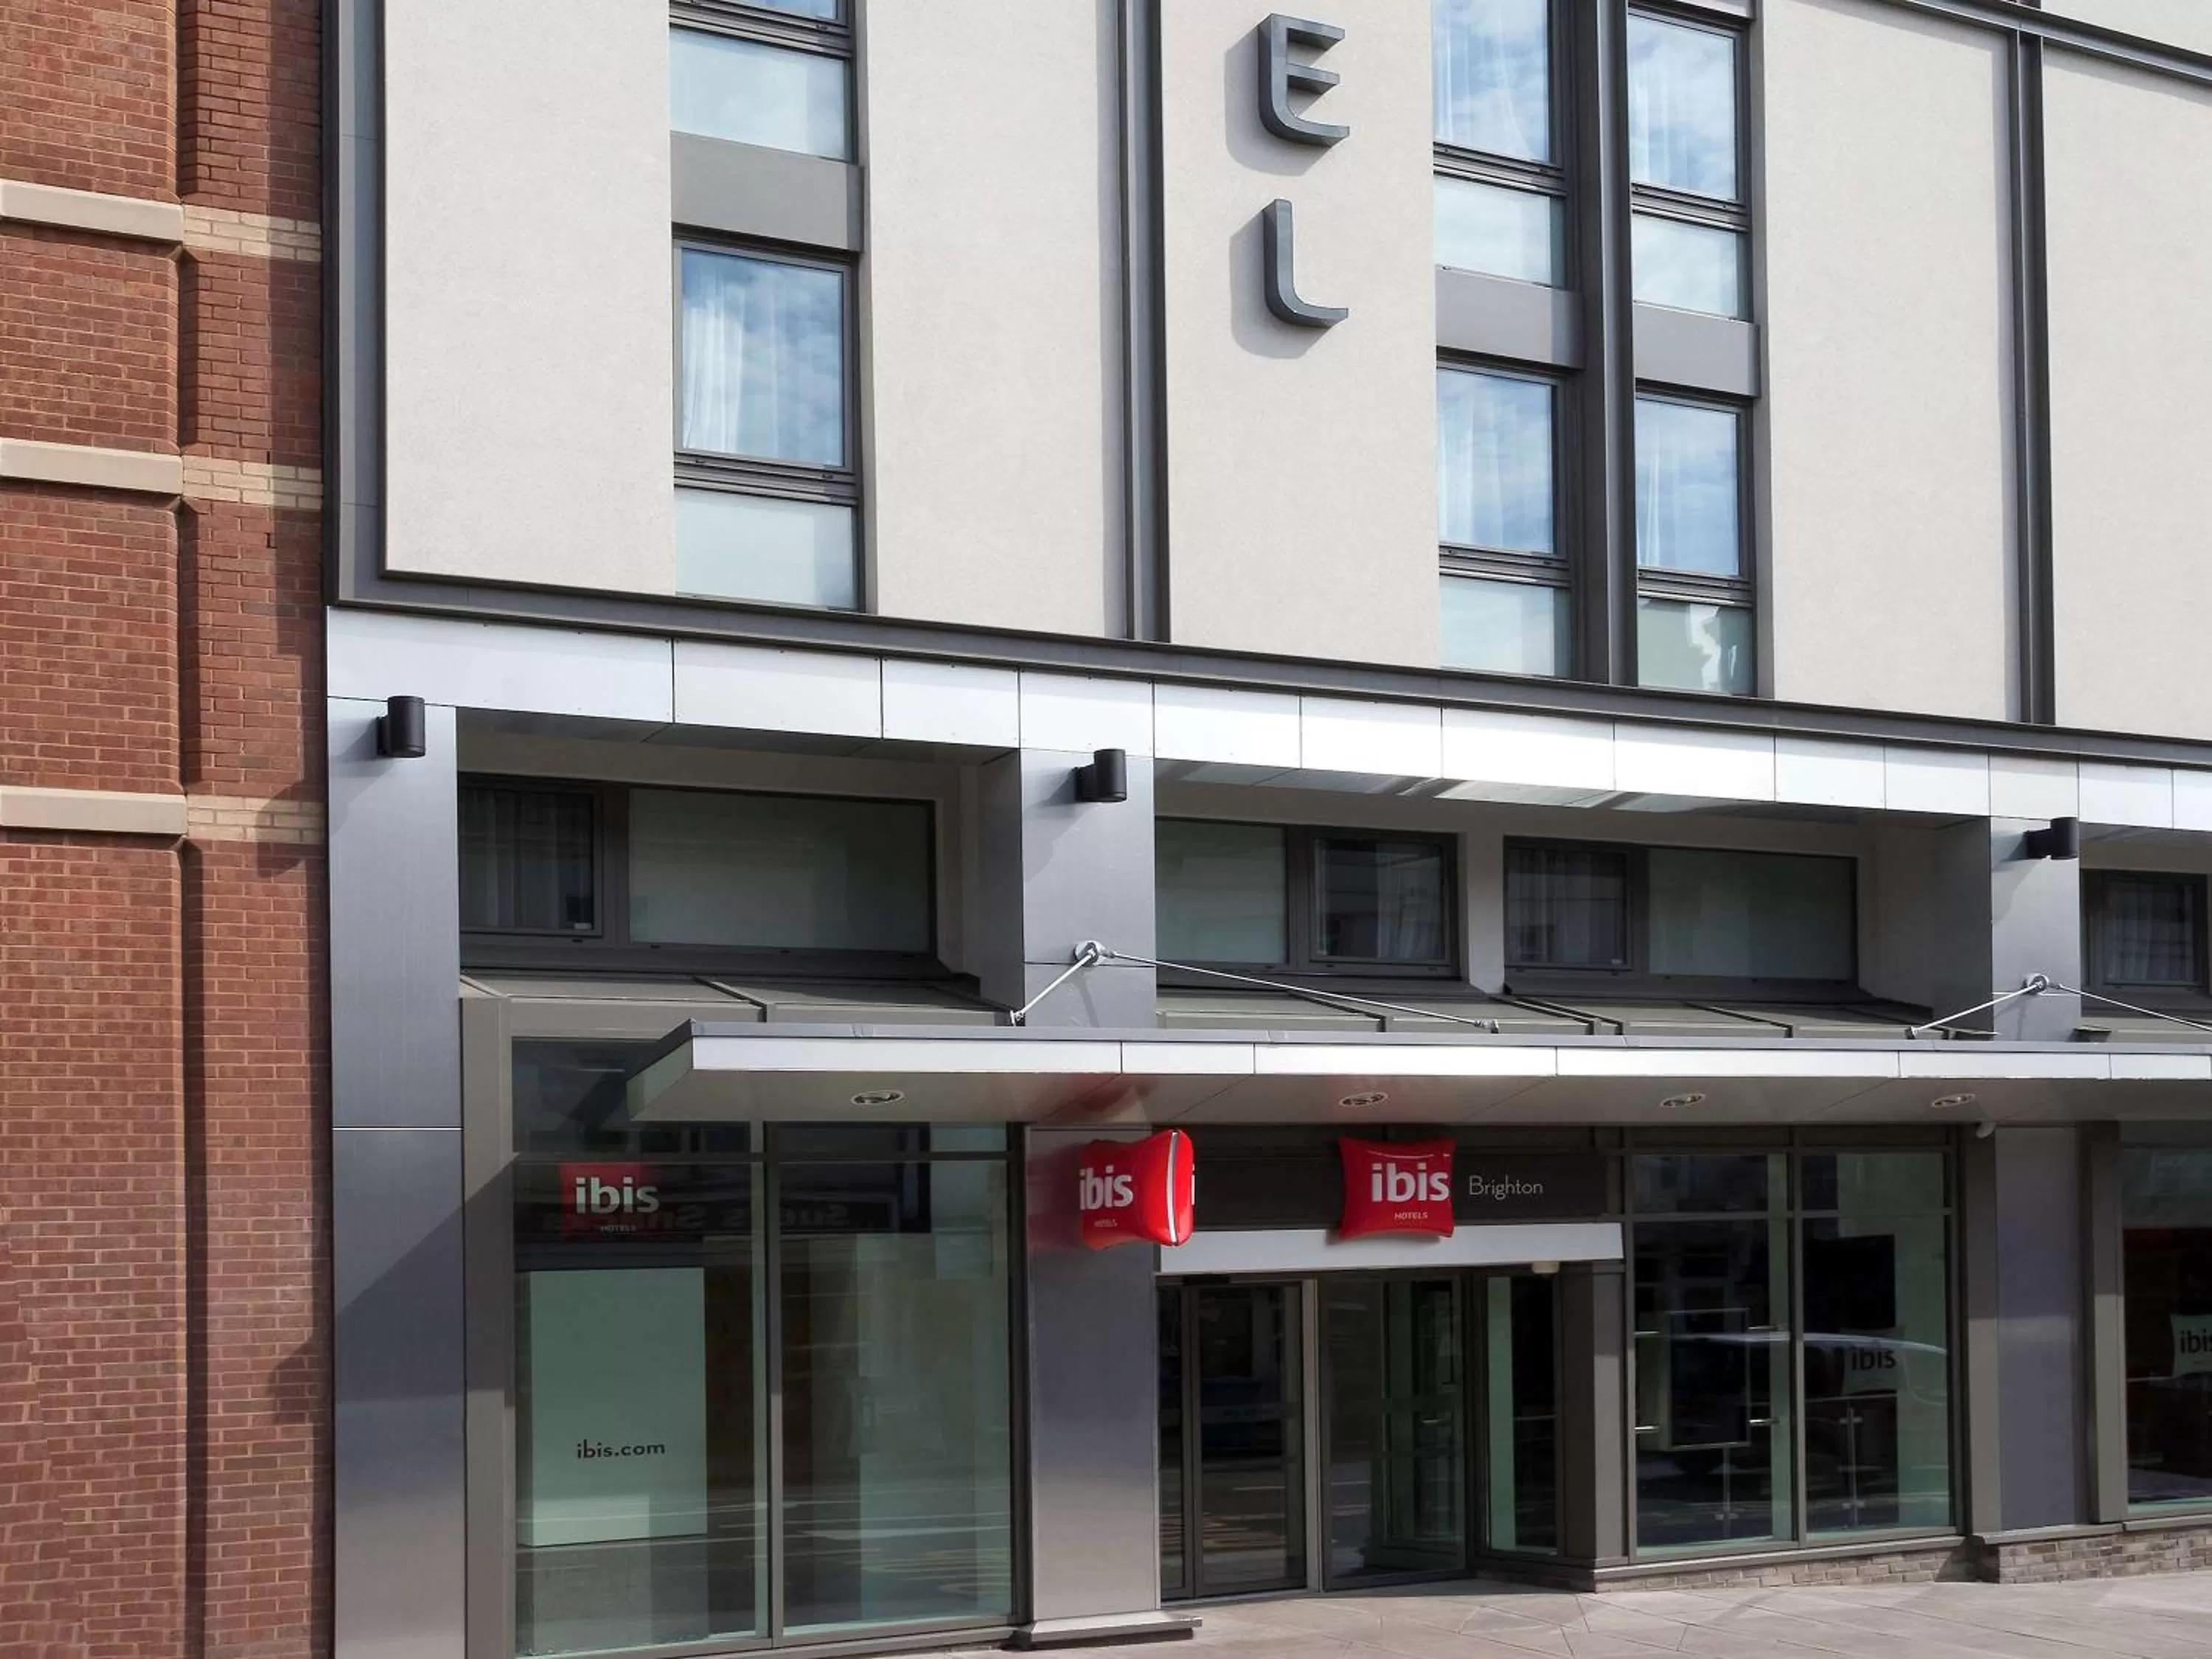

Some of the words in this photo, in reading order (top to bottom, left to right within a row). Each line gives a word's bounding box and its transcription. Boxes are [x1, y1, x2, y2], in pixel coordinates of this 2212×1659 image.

[574, 1175, 661, 1215] ibis
[1079, 1164, 1134, 1211] ibis
[1371, 1162, 1450, 1203] ibis
[1468, 1174, 1544, 1200] Brighton
[1394, 1211, 1429, 1220] HOTELS
[577, 1439, 665, 1458] ibis.com
